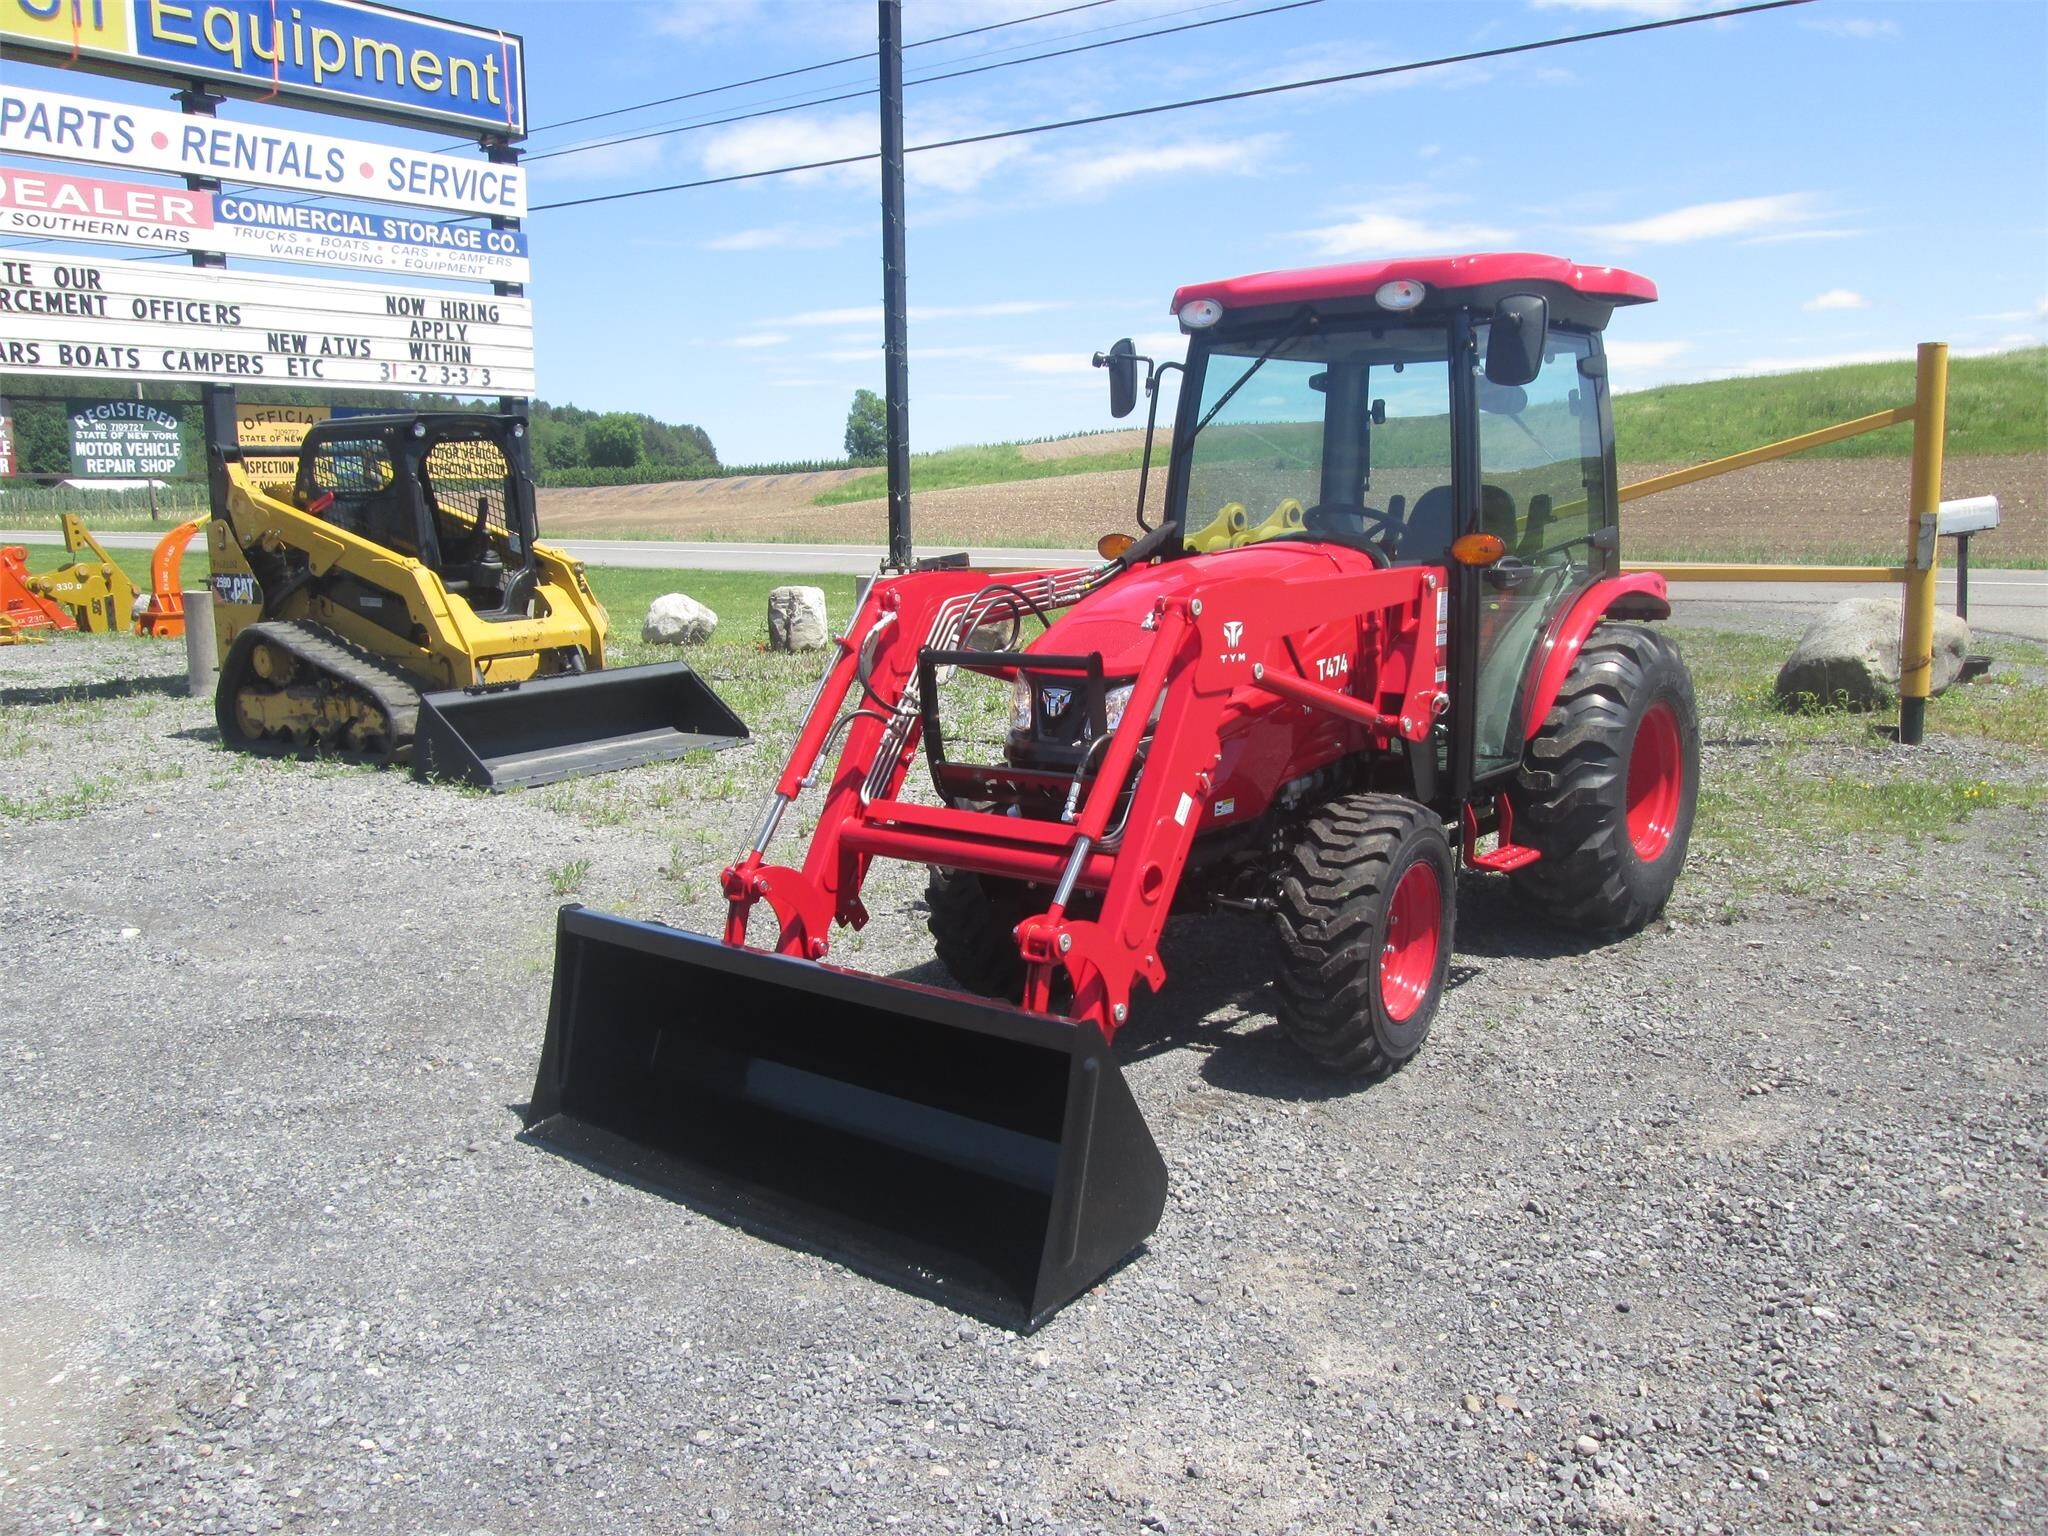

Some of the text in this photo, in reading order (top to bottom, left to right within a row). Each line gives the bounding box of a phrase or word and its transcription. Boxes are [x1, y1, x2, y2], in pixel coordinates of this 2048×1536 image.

[151, 0, 501, 105] Equipment
[0, 97, 517, 207] PARTS RENTALS SERVICE
[0, 175, 197, 225] EALER
[12, 212, 190, 243] SOUTHERN CARS
[221, 199, 520, 254] COMMERCIAL STORAGE CO.
[233, 226, 513, 268] TRUCKS BOATS CARS CAMPERS
[270, 243, 485, 275] WAREHOUSING EQUIPMENT
[54, 266, 102, 290] OUR
[132, 298, 242, 326] OFFICERS
[386, 295, 500, 323] NOW HIRING
[410, 320, 468, 342] APPLY
[267, 332, 371, 360] NEW ATVS
[408, 342, 471, 364] WITHIN
[59, 344, 141, 369] BOATS
[162, 350, 264, 375] CAMPERS
[287, 357, 324, 378] ETC
[74, 402, 178, 430] REGISTERED
[110, 423, 144, 432] 7109727
[243, 410, 322, 431] OFFICIA
[75, 432, 179, 440] STATE OF NEW YORK
[75, 442, 182, 457] MOTOR VEHICLE
[86, 458, 176, 473] REPAIR SHOP
[245, 461, 294, 474] NSPECTION
[56, 583, 73, 591] 330
[233, 577, 254, 603] CAT
[1220, 653, 1246, 663] TYM
[1316, 653, 1348, 681] T474
